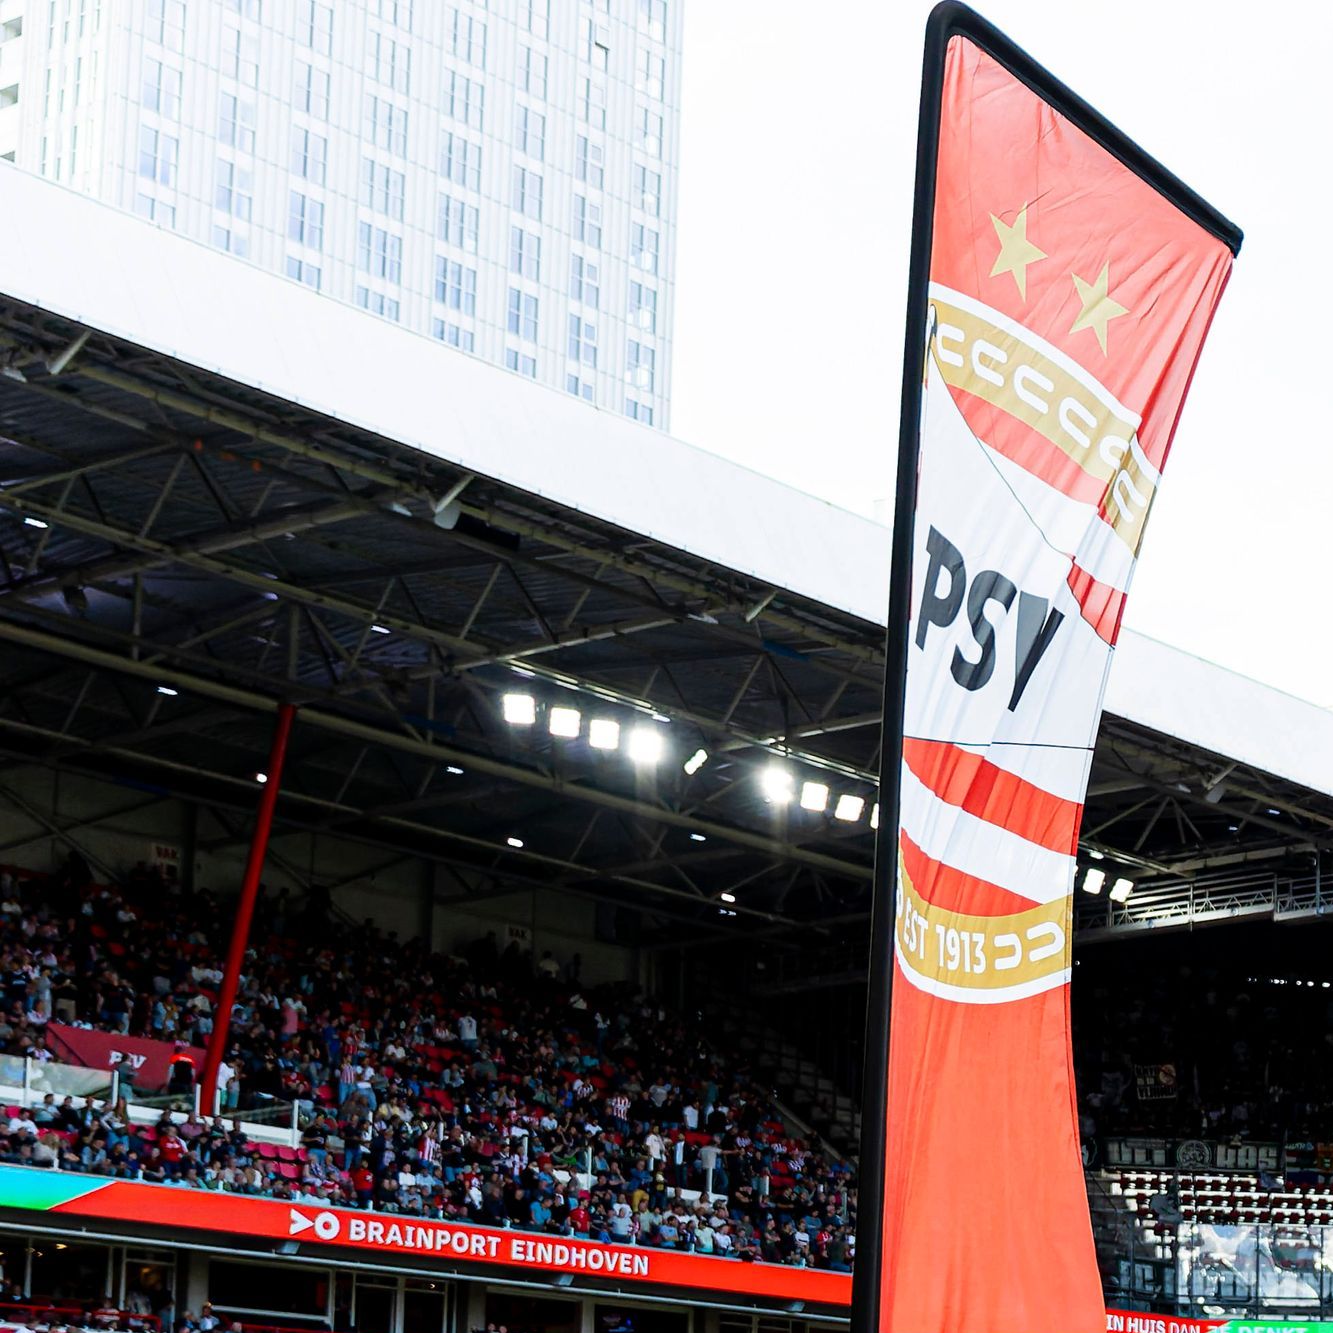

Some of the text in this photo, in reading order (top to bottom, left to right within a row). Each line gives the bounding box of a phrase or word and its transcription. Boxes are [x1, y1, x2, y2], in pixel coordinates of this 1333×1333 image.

[915, 524, 1065, 712] PSV
[904, 897, 986, 975] EST 1913
[349, 1218, 649, 1277] BRAINPORT EINDHOVEN
[1107, 1314, 1124, 1332] IN
